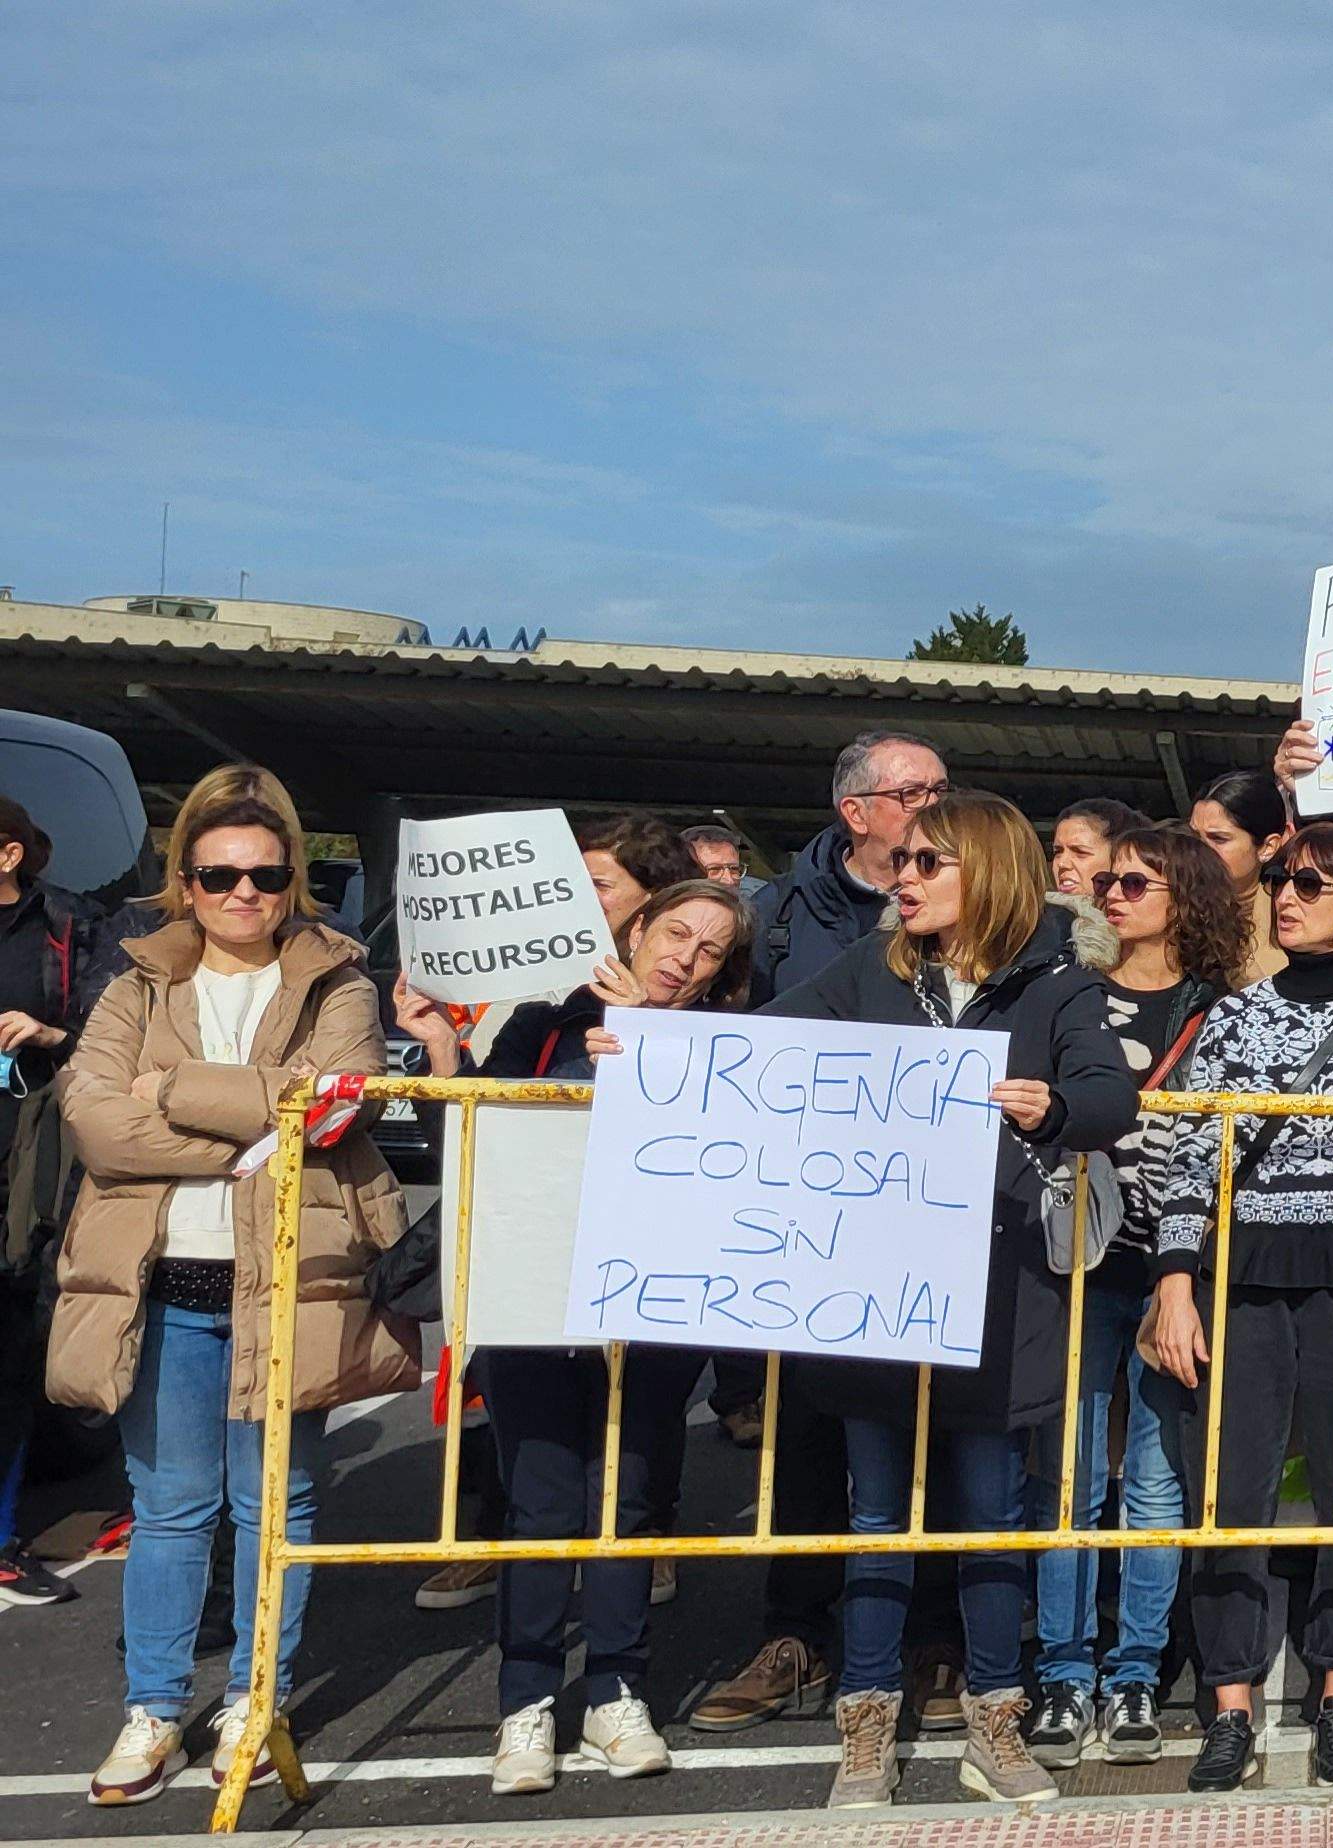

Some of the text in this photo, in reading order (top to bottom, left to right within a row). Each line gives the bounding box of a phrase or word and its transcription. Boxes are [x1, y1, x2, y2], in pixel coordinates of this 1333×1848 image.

[408, 839, 536, 877] MEJORES
[402, 878, 574, 921] HOSPITALES
[421, 929, 597, 976] RECURSOS
[634, 1135, 969, 1208] COLOSAL
[590, 1259, 981, 1353] PERSONAL
